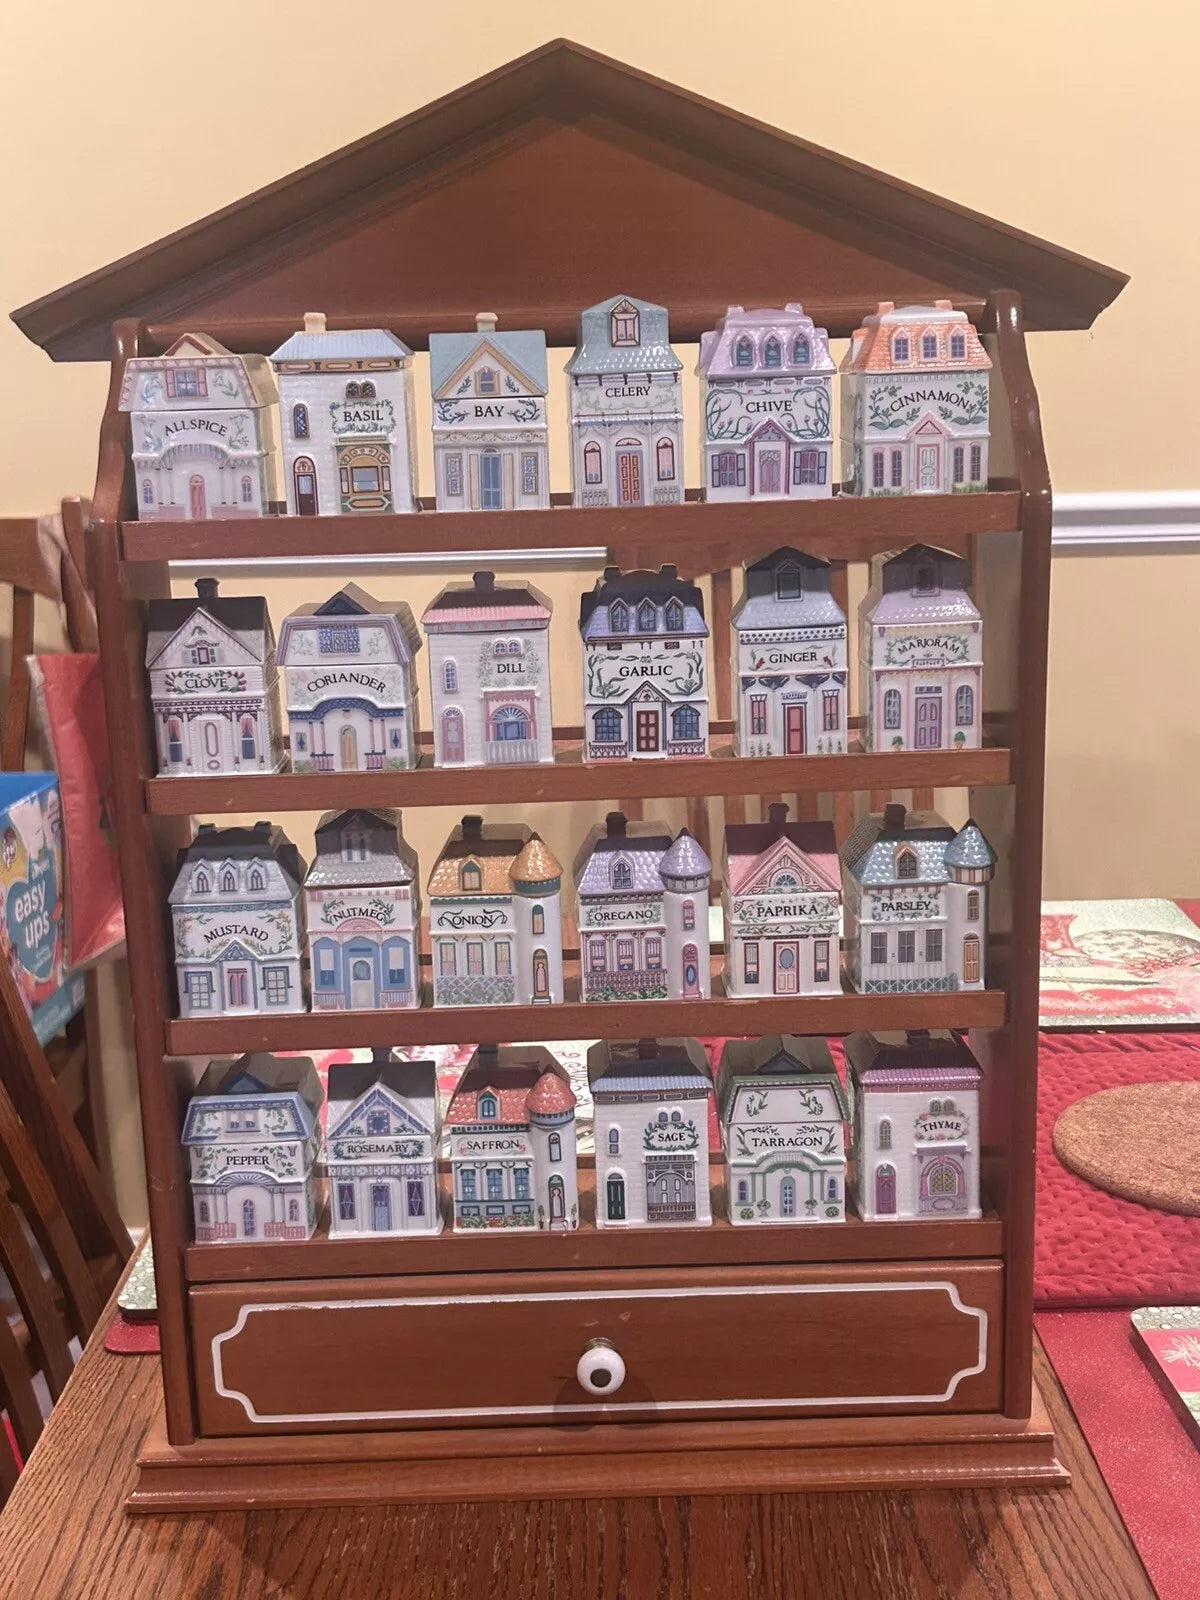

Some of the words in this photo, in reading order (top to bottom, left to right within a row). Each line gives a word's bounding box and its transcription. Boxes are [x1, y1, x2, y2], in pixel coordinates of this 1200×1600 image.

[605, 386, 651, 398] CELERY
[745, 400, 793, 413] CHIVE
[890, 390, 970, 412] CINNAMON
[343, 410, 384, 422] BASIL
[474, 406, 504, 418] BAY
[164, 419, 228, 437] ALLSPICE
[897, 638, 960, 655] MARJORAM
[769, 652, 817, 664] GINGER
[497, 663, 525, 674] DILL
[619, 665, 673, 677] GARLIC
[184, 678, 227, 689] CLOVE
[307, 672, 386, 693] CORIANDER
[15, 879, 46, 923] easy
[881, 901, 931, 912] PARSLEY
[333, 907, 385, 922] NUTMEG
[594, 909, 653, 921] OREGANO
[756, 904, 818, 918] PAPRIKA
[452, 914, 493, 925] ONION
[25, 910, 50, 949] ups
[203, 924, 269, 943] MUSTARD
[920, 1120, 962, 1132] THYME
[658, 1132, 686, 1142] SAGE
[751, 1136, 823, 1148] TARRAGON
[347, 1144, 409, 1154] ROSEMARY
[467, 1139, 520, 1150] SAFFRON
[226, 1155, 270, 1166] PEPPER
